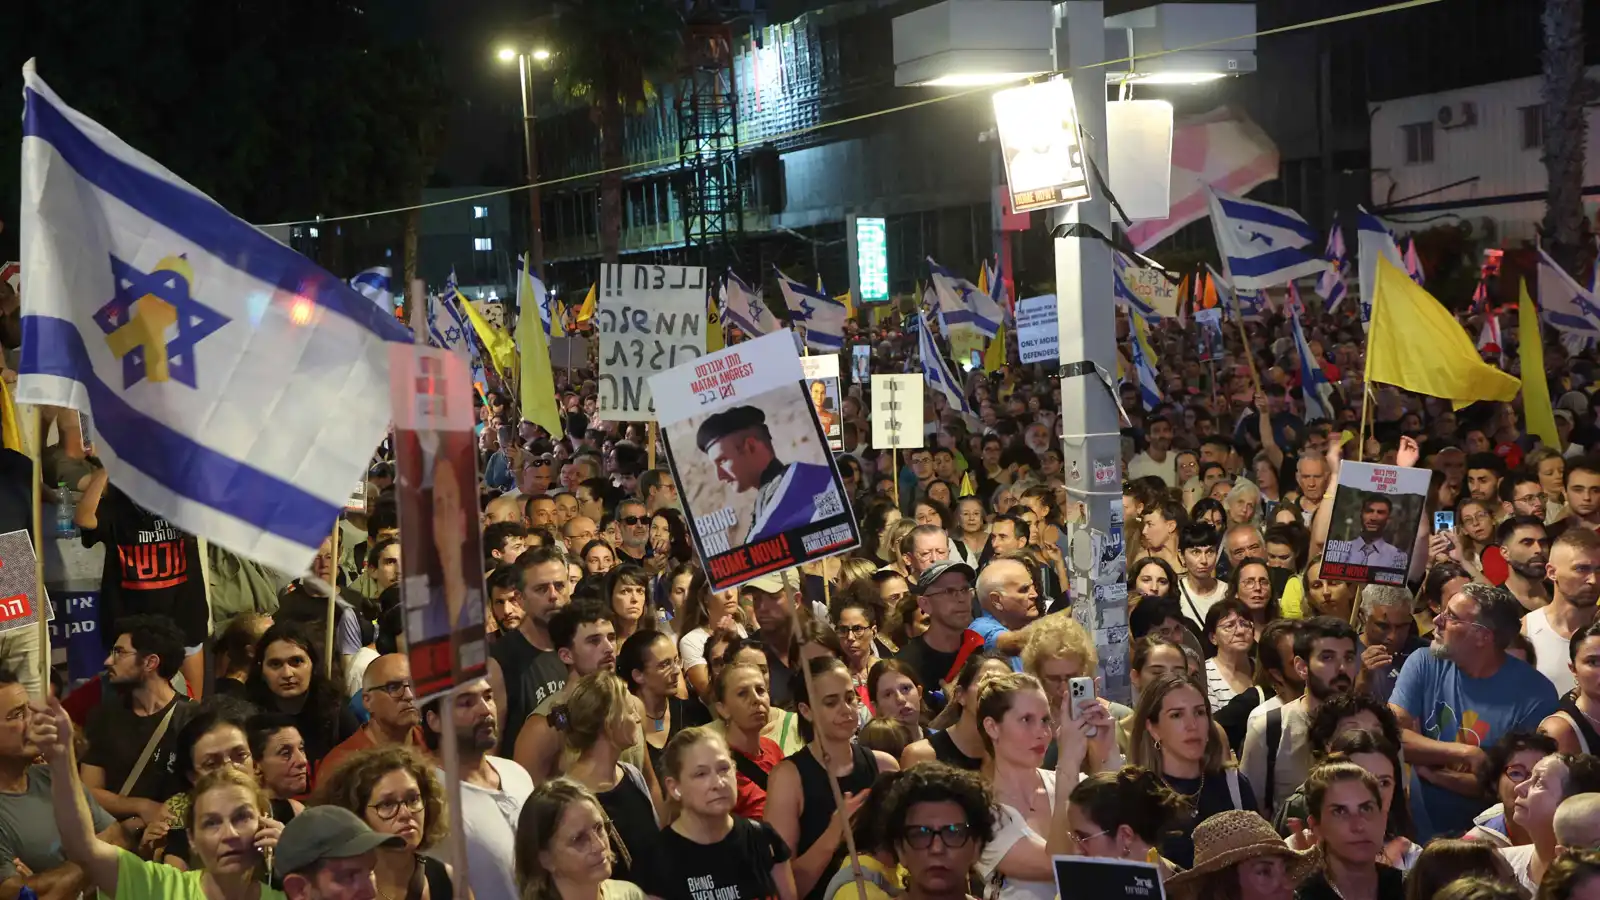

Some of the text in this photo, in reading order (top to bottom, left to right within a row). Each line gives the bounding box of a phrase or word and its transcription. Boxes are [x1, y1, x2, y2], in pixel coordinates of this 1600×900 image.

[600, 306, 700, 337] ממשלה
[1021, 336, 1058, 348] ONLY MORE
[1023, 347, 1059, 360] DEFENDERS
[690, 362, 754, 394] MATAN ANGREST
[699, 390, 717, 405] 22
[695, 507, 738, 536] BRING
[138, 528, 166, 543] הביתה
[701, 530, 731, 558] HIM
[804, 535, 831, 553] FAMILIES
[830, 528, 854, 546] FORUM
[1327, 540, 1352, 552] BRING
[117, 539, 188, 580] עכשיו
[709, 532, 791, 580] HOME NOW!
[1325, 550, 1341, 562] HIM
[1323, 564, 1345, 576] HOME
[65, 596, 94, 614] אין
[65, 620, 96, 638] סגן
[714, 885, 741, 900] HOME
